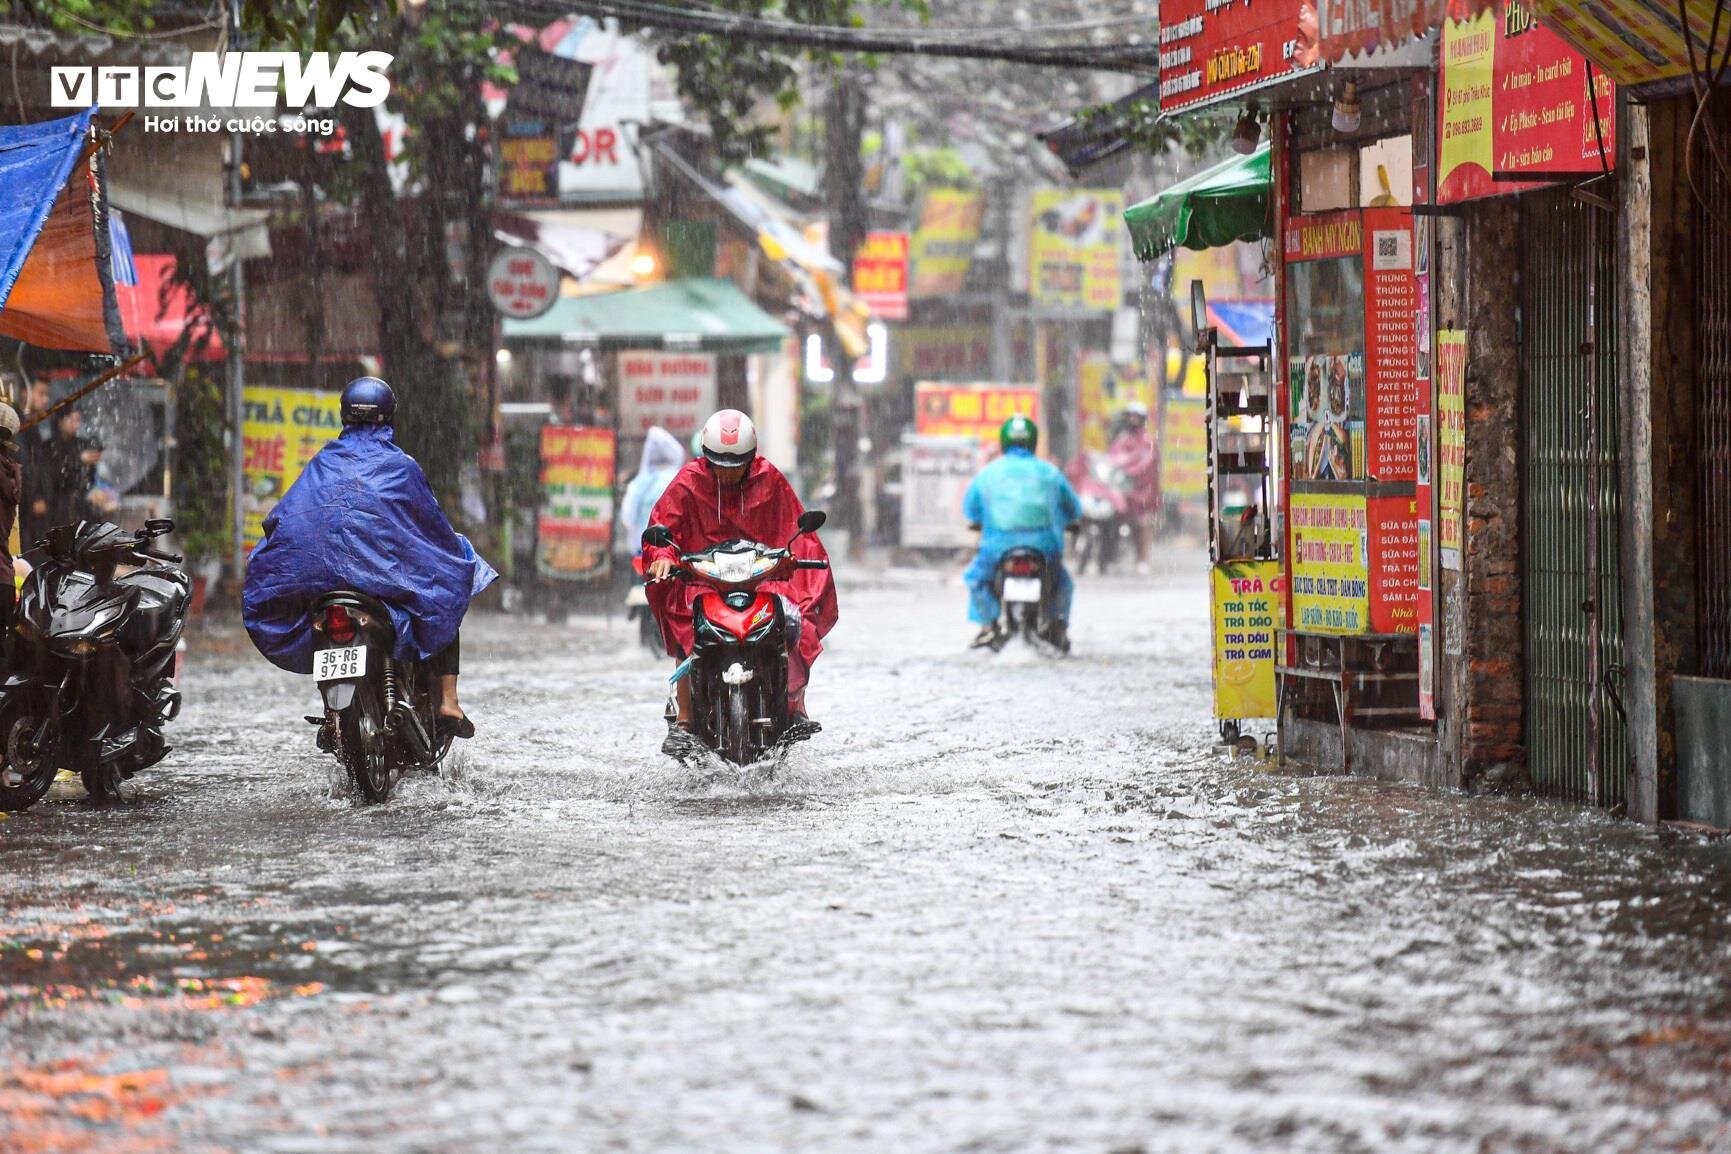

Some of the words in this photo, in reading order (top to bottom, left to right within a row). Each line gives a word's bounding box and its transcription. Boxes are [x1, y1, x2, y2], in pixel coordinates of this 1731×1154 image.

[1511, 71, 1517, 89] In
[1519, 67, 1531, 87] màu
[1537, 64, 1543, 83] In
[1545, 59, 1558, 80] card
[1519, 109, 1537, 129] Plastic
[1542, 106, 1555, 124] Scan
[1509, 151, 1515, 168] In
[1531, 145, 1541, 164] báo
[1543, 143, 1552, 162] cáo
[1378, 406, 1400, 414] PATE
[1378, 418, 1401, 427] PATE
[1379, 453, 1392, 463] GÀ
[1395, 454, 1416, 462] ROTI
[1395, 464, 1413, 474] XÀO
[1224, 600, 1244, 612] TRÀ
[1248, 598, 1268, 612] TÁC
[1391, 607, 1414, 618] Nhà
[1224, 616, 1244, 628] TRÀ
[1224, 632, 1244, 644] TRÀ
[322, 649, 358, 664] 36-R6
[1224, 648, 1245, 660] TRÀ
[1248, 648, 1271, 660] CAM
[321, 662, 357, 678] 9796
